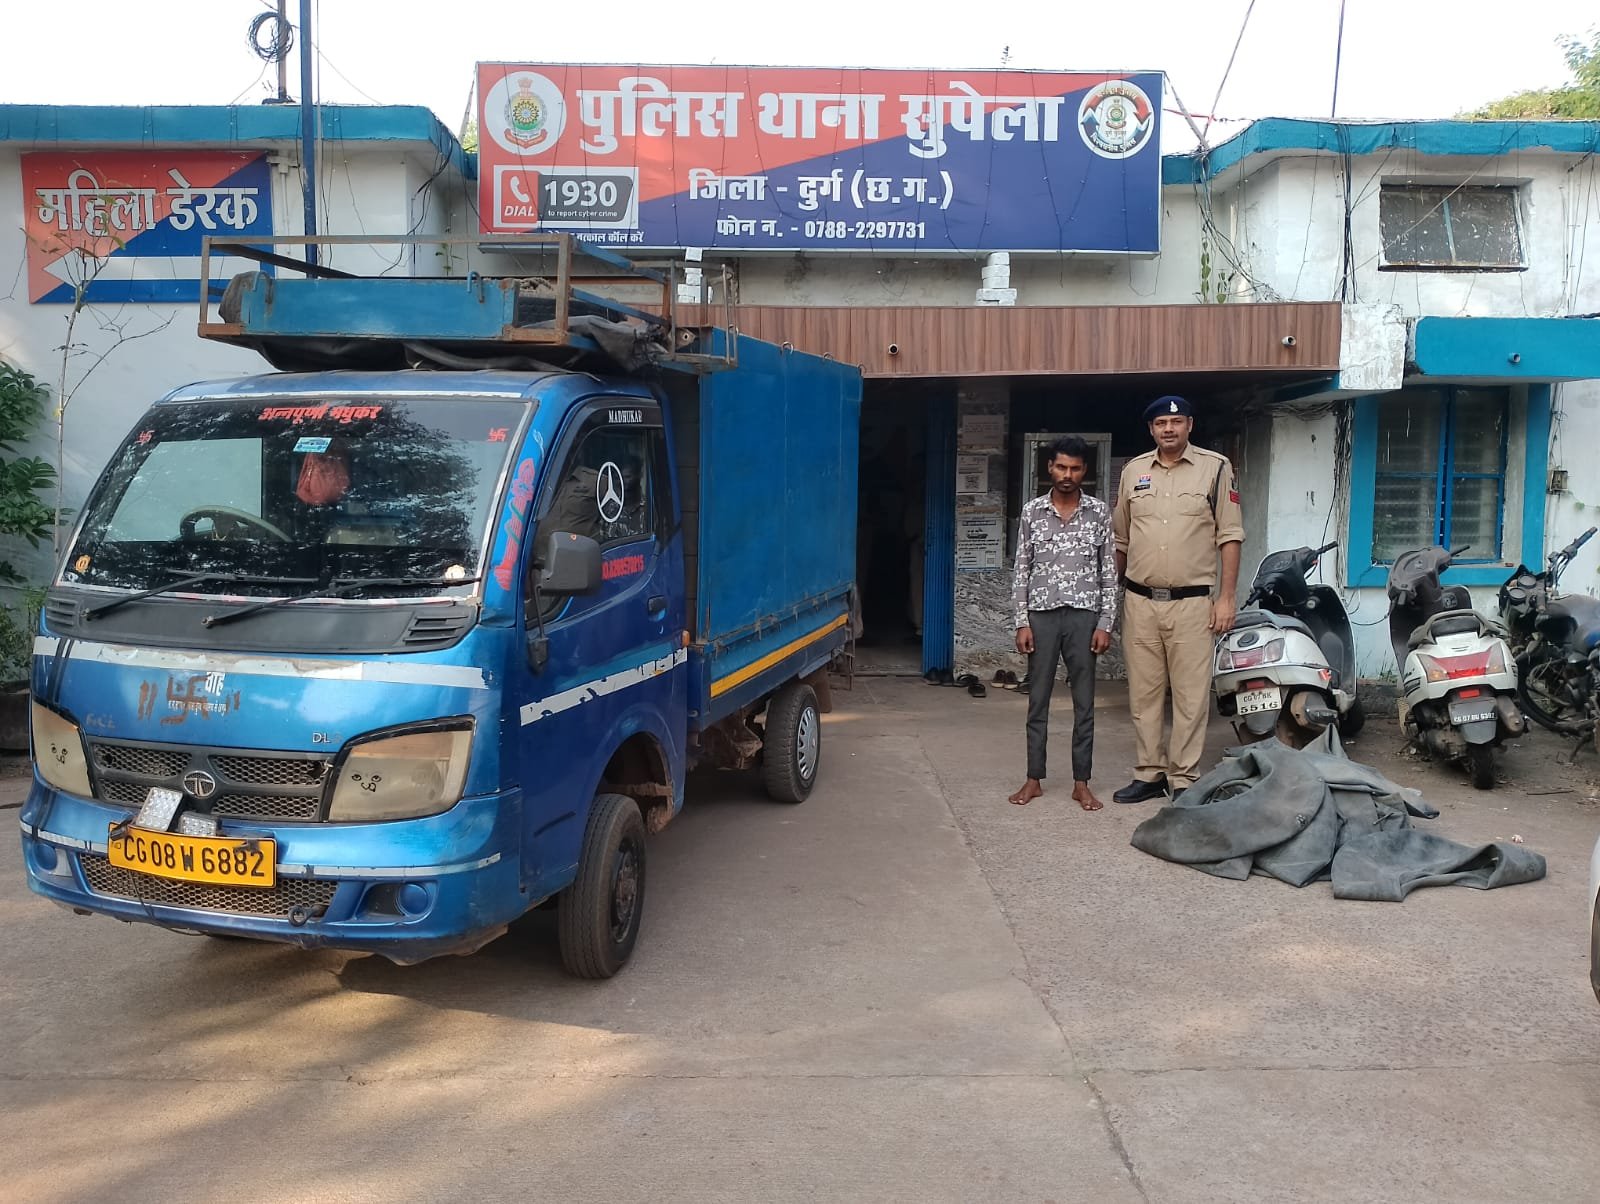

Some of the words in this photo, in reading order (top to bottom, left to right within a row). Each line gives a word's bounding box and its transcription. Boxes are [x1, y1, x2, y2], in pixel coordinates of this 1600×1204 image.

[576, 77, 744, 154] पुलिस
[758, 91, 885, 139] थाना
[899, 80, 1065, 158] सुपेला
[544, 180, 618, 207] 1930
[688, 168, 768, 200] जिला
[798, 168, 843, 210] दुर्ग
[850, 169, 954, 210] (छ.ग.)
[35, 169, 157, 237] महिला
[504, 205, 535, 217] DIAL
[548, 209, 555, 217] to
[557, 210, 577, 219] report
[578, 209, 598, 219] cyber
[608, 230, 629, 242] कॉल
[630, 230, 645, 242] करें
[716, 215, 756, 237] फोन
[761, 219, 784, 237] न.
[805, 221, 926, 239] 0788-2297731
[608, 409, 642, 423] MADHUKAR
[123, 835, 176, 869] CG08
[180, 843, 195, 872] W
[202, 846, 266, 878] 6882
